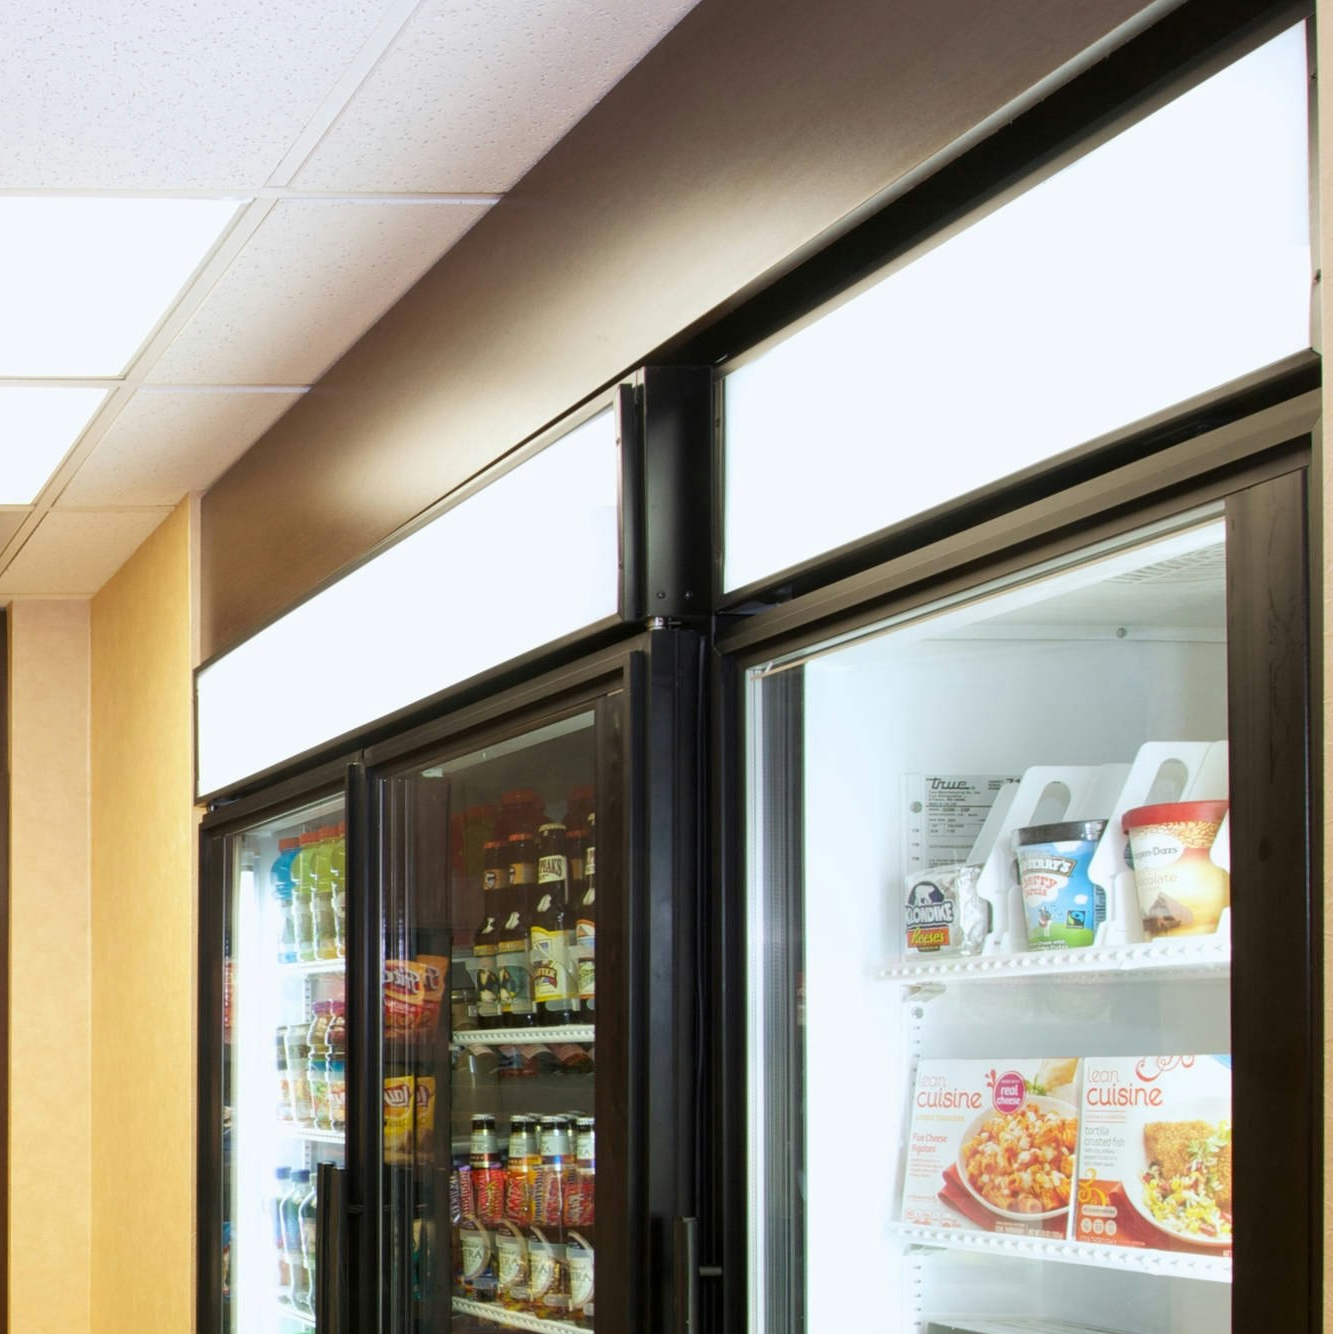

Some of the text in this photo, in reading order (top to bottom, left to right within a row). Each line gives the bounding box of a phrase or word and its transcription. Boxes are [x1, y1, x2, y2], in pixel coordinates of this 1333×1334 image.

[917, 1075, 946, 1088] lean
[1087, 1067, 1119, 1083] lean
[1001, 1084, 1018, 1096] real
[1086, 1083, 1164, 1106] cuisine
[917, 1088, 982, 1109] cuisine
[997, 1097, 1021, 1105] cheese
